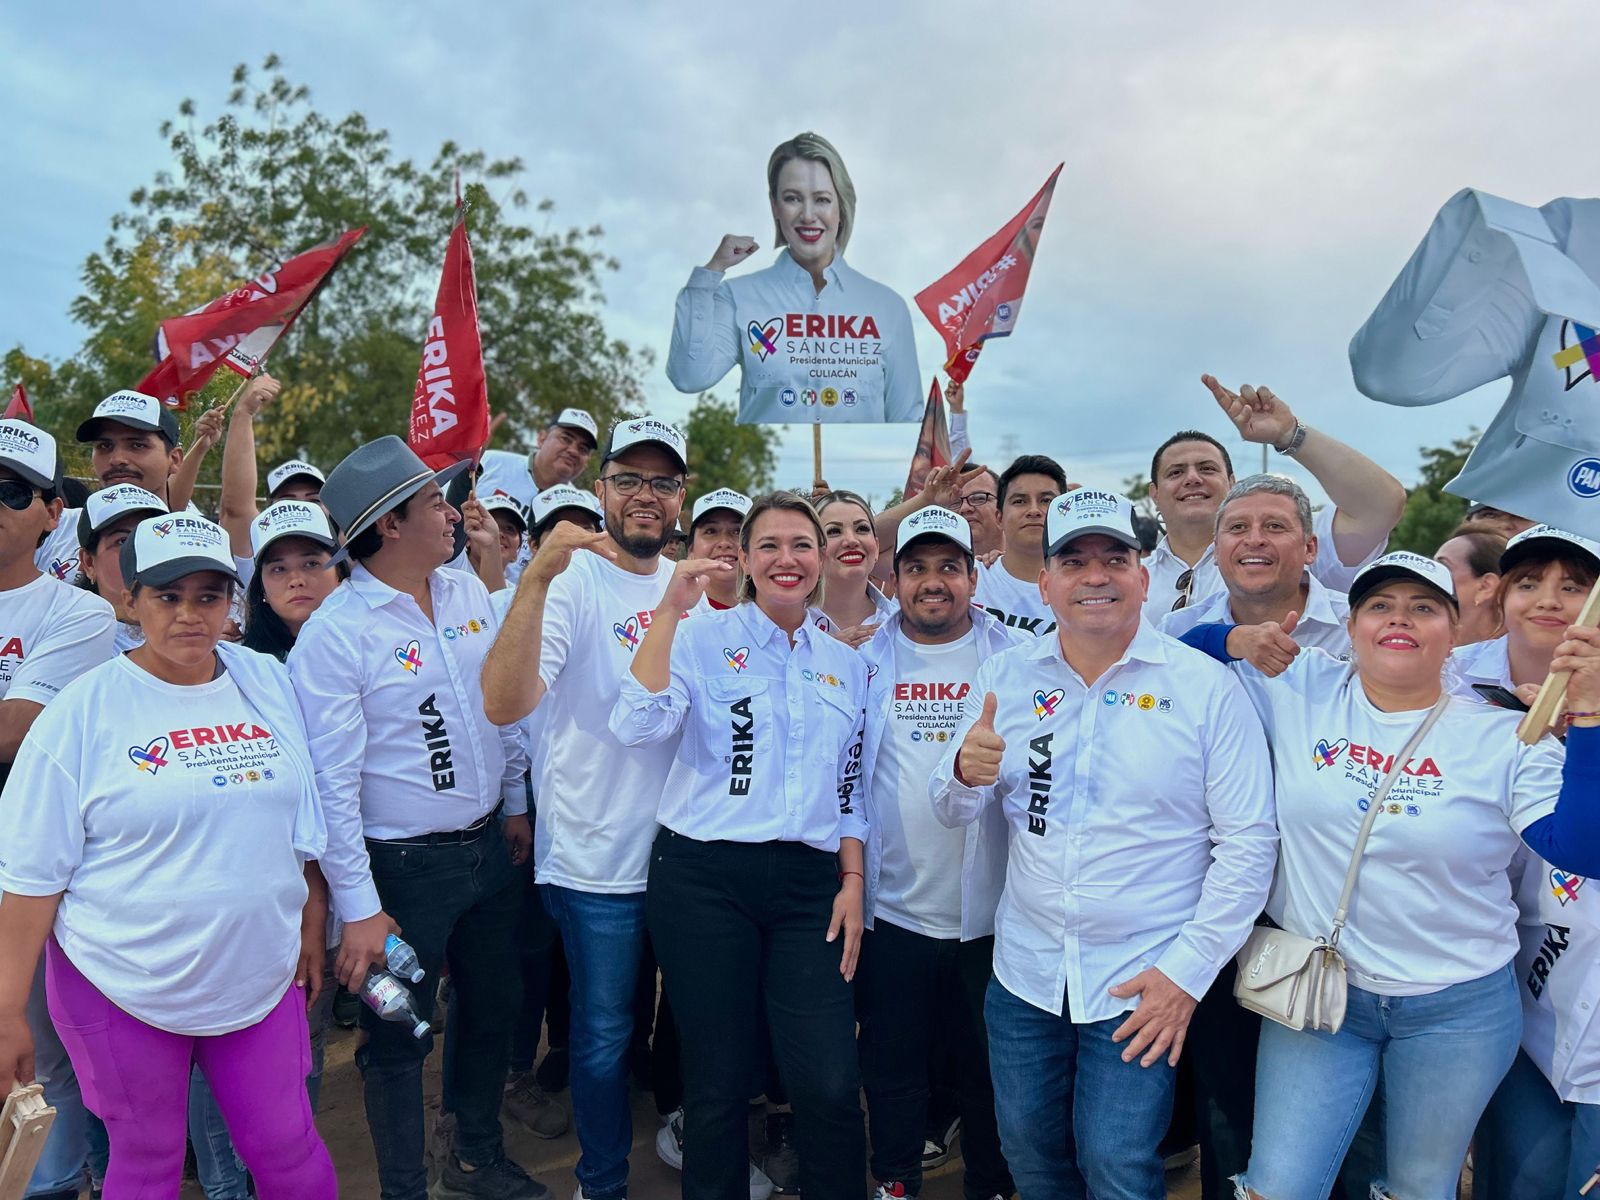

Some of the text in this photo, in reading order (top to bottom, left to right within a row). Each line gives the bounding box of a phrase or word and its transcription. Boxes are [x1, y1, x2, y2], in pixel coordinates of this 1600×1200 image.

[786, 313, 881, 340] ERIKA
[786, 338, 882, 355] SÁNCHEZ
[790, 356, 879, 367] Presidenta Municipal
[424, 315, 458, 437] ERIKA
[809, 367, 857, 378] CULIACÁN
[111, 395, 148, 405] ERIKA
[414, 378, 430, 443] CHEZ
[646, 421, 680, 441] ERIKA
[286, 464, 313, 472] ERIKA
[120, 487, 159, 503] ERIKA
[717, 490, 746, 503] ERIKA
[1074, 491, 1118, 504] ERIKA
[271, 504, 312, 518] ERIKA
[923, 509, 958, 522] ERIKA
[175, 518, 221, 536] ERIKA
[1389, 554, 1436, 569] ERIKA
[895, 683, 971, 701] ERIKA
[894, 701, 965, 713] SÁNCHE
[897, 713, 963, 721] Presidenta Munici
[917, 720, 956, 729] CULIACÁN
[168, 722, 272, 750] ERIKA
[418, 692, 456, 792] ERIKA
[177, 738, 278, 762] SÁNCHEZ
[729, 696, 754, 796] ERIKA
[185, 750, 281, 769] Presidenta Municipal
[216, 760, 265, 772] CULIACÁN
[1348, 742, 1442, 778] ERIKA
[1344, 758, 1445, 791] SÁNHEZ
[1027, 732, 1054, 837] ERIKA
[1391, 788, 1440, 797] Municipal
[1526, 922, 1570, 1001] ERIKA
